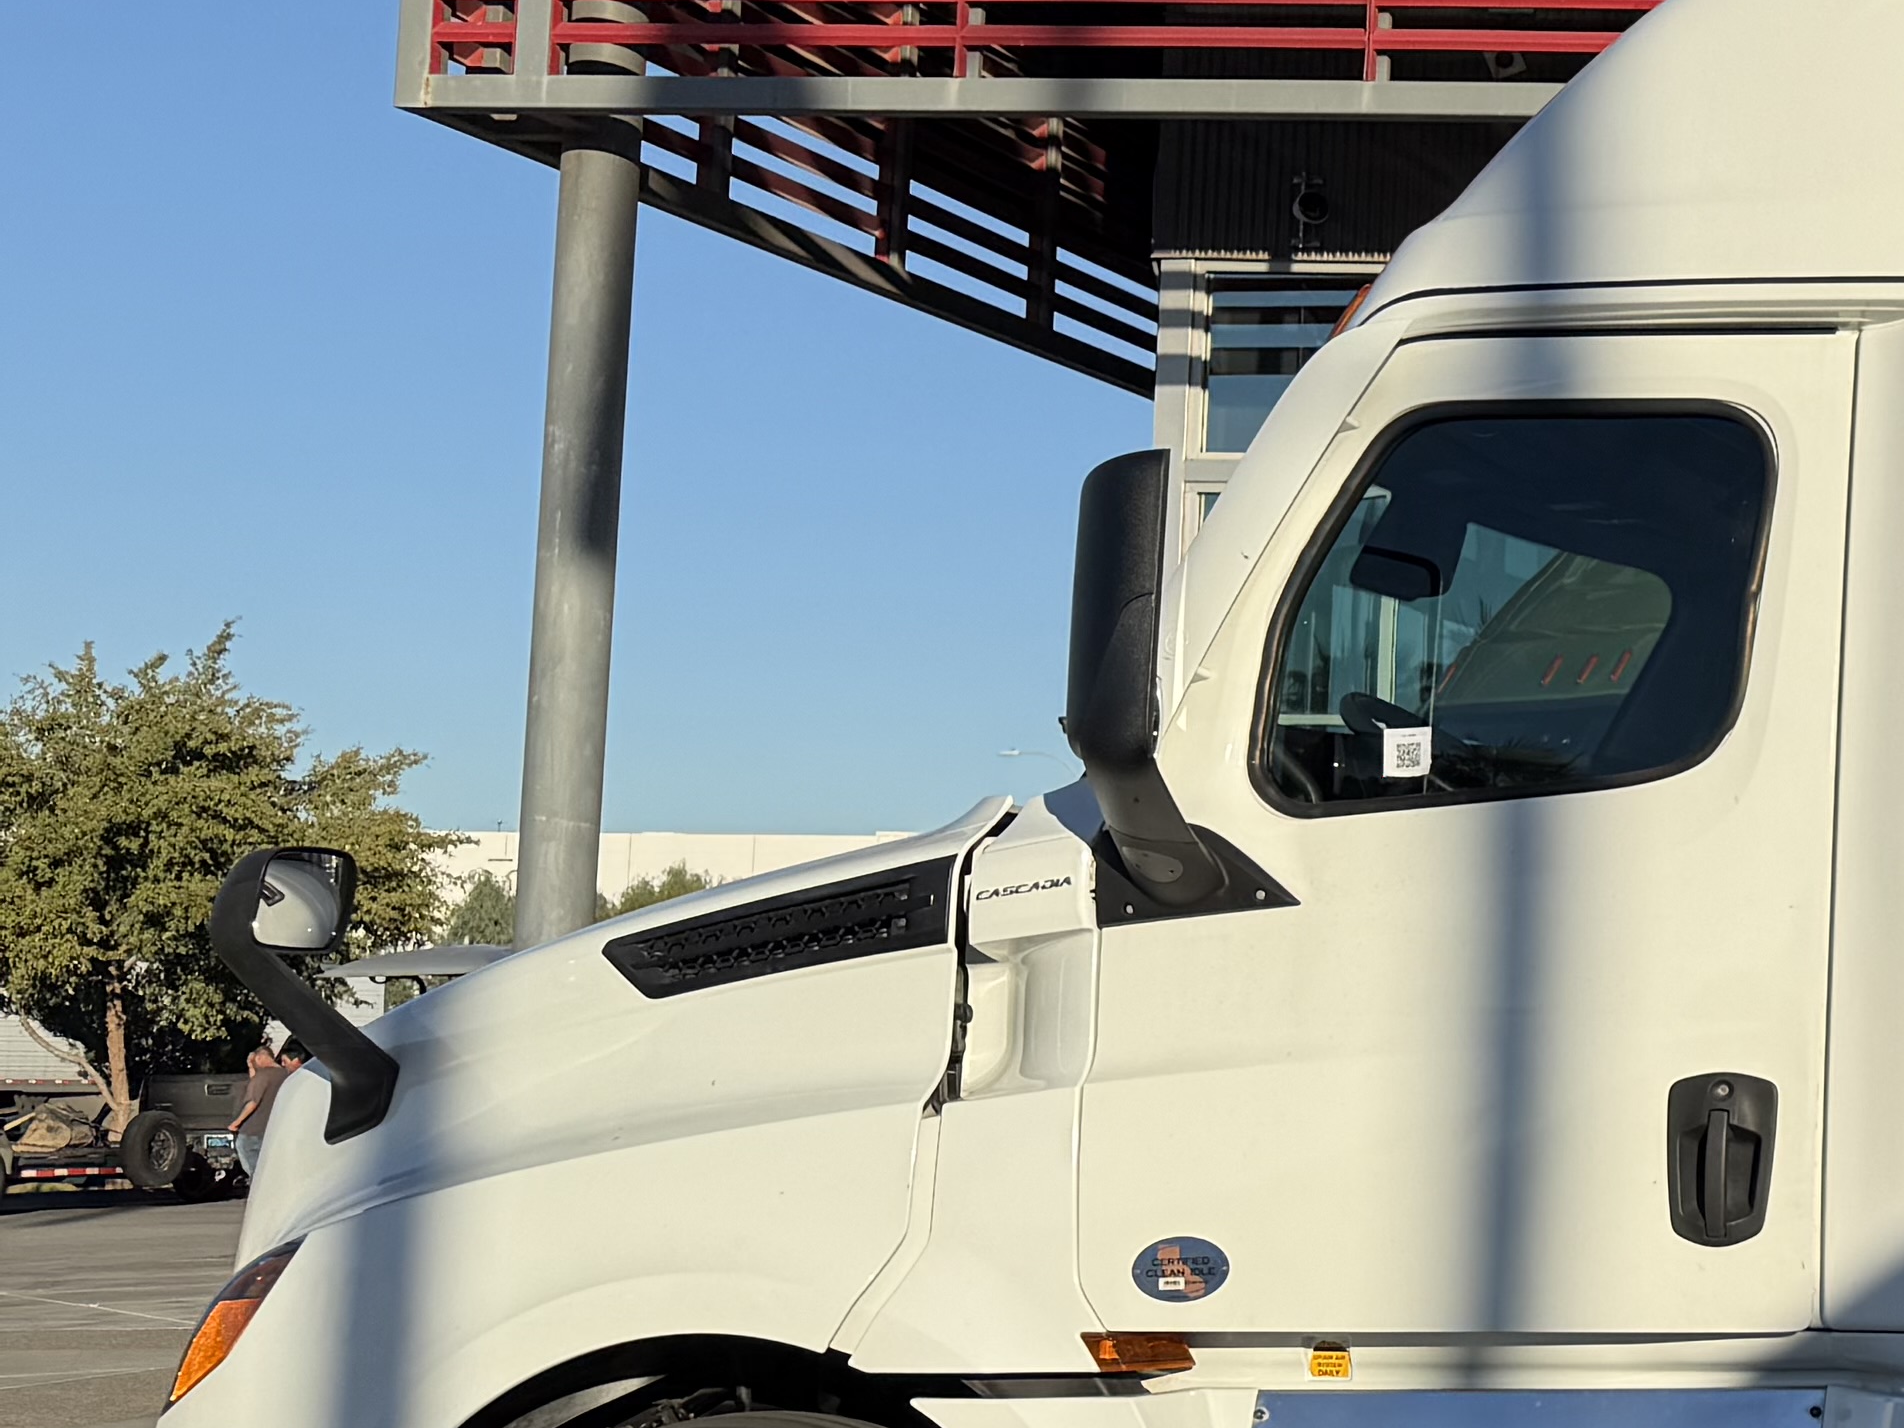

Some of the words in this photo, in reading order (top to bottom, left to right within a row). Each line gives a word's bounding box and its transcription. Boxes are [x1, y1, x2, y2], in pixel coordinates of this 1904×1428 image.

[975, 875, 1072, 901] CASCADIA
[1151, 1256, 1210, 1267] CERTIFIED
[1145, 1268, 1185, 1278] CLEAN
[1190, 1266, 1216, 1276] IDLE
